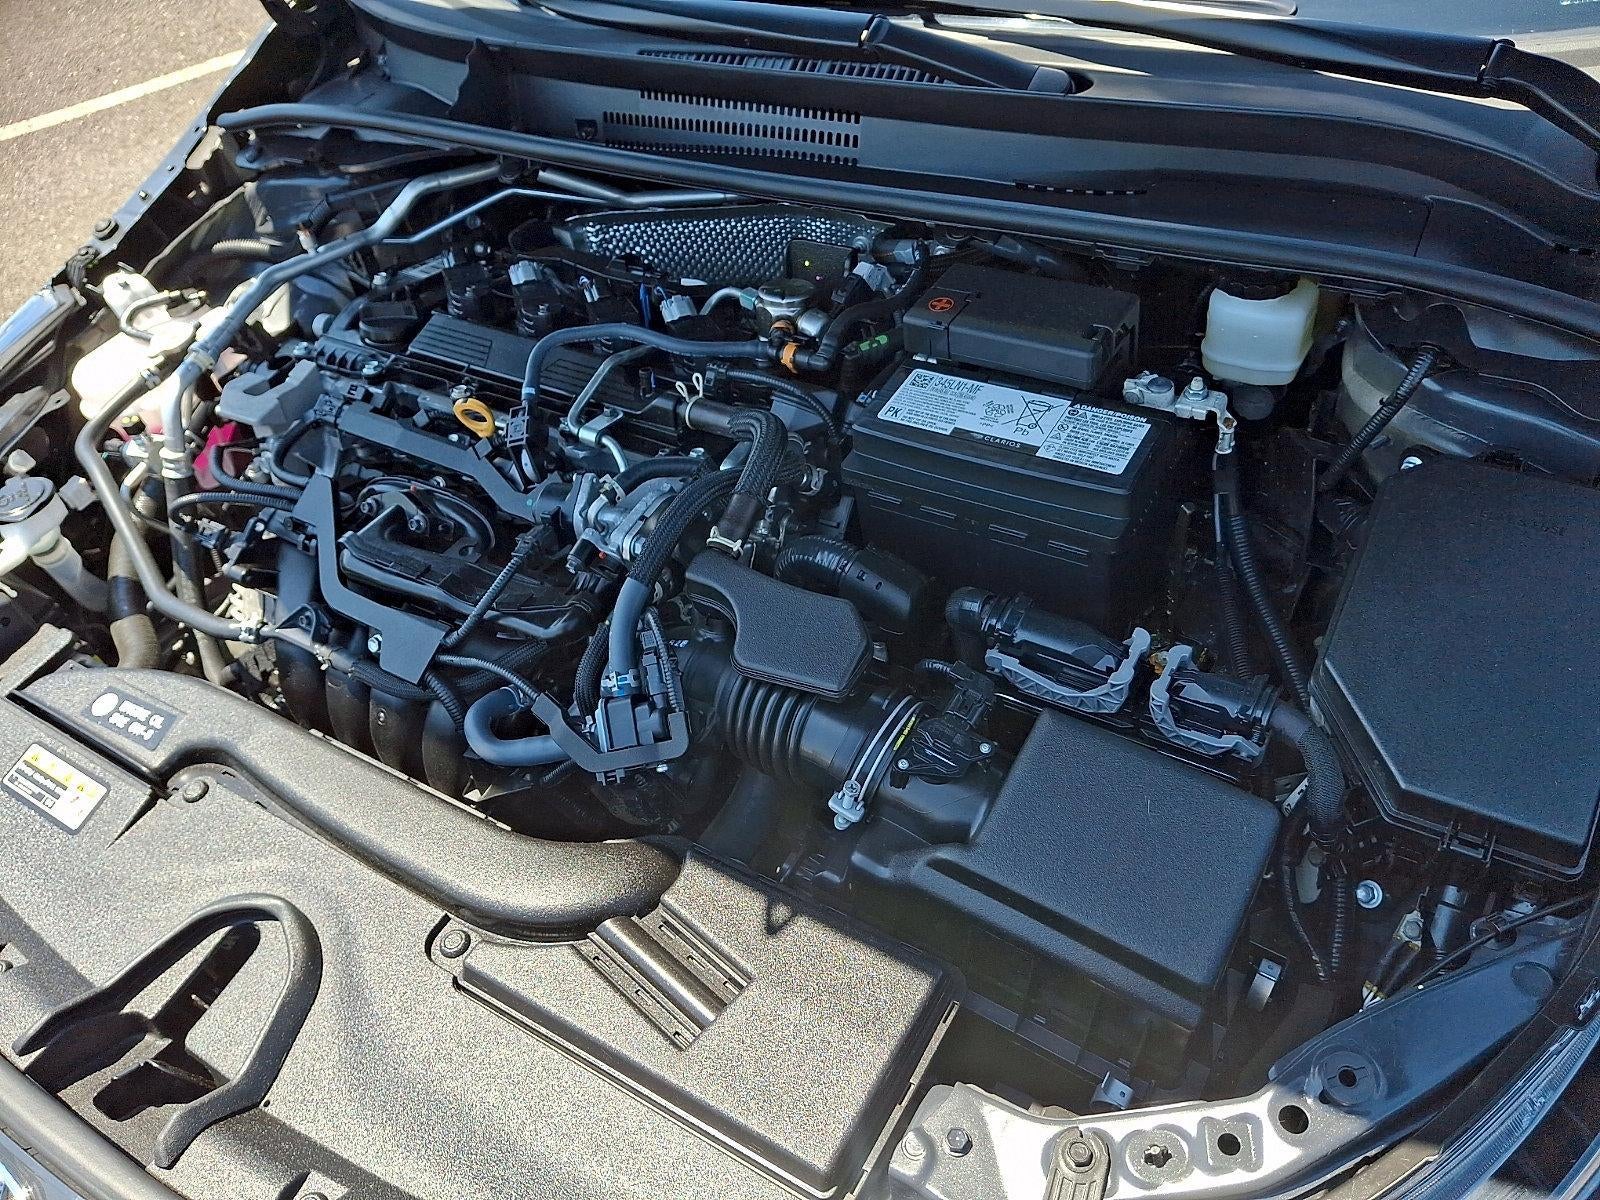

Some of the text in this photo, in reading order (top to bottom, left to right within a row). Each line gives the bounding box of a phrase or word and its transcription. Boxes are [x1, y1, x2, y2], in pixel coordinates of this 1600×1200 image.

[884, 405, 903, 418] PK
[1080, 405, 1148, 422] DANGER/POISON
[1013, 426, 1030, 436] Pb
[984, 435, 1021, 449] CLARIOS
